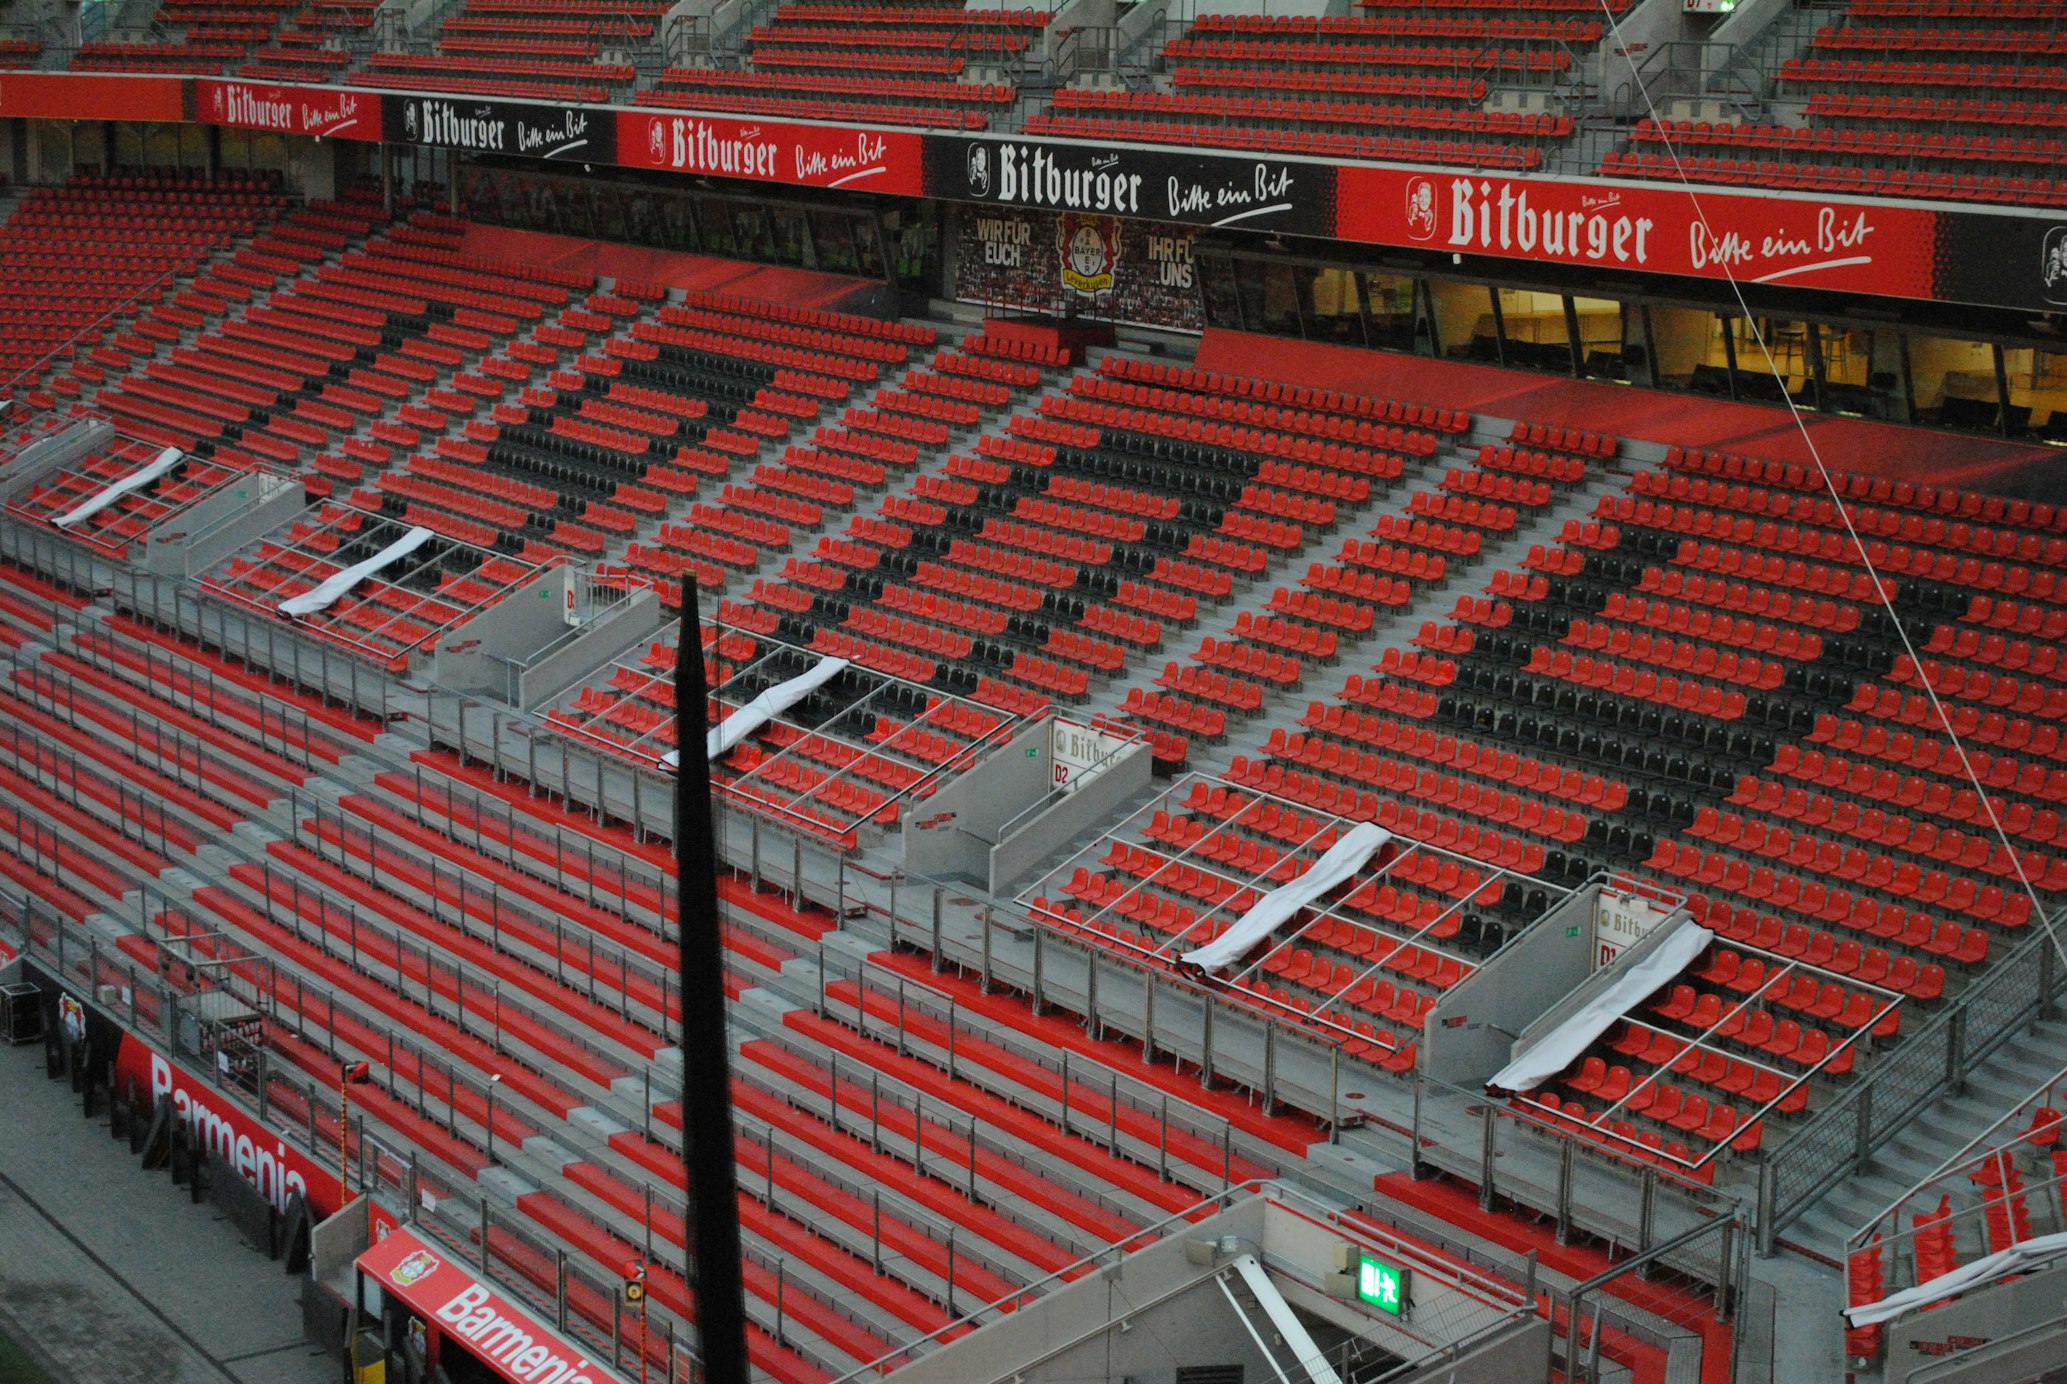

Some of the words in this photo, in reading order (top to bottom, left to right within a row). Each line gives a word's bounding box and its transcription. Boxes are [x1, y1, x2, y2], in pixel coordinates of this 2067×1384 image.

[227, 85, 292, 128] Bitburger
[302, 104, 323, 130] Bitte
[324, 106, 340, 123] ein
[340, 94, 358, 118] Bit
[423, 100, 505, 150] Bitburger
[518, 121, 544, 151] Bitte
[545, 124, 565, 142] ein
[566, 110, 588, 139] Bit
[672, 118, 777, 177] Bitburger
[795, 144, 828, 179] Bitte
[831, 149, 856, 169] ein
[858, 133, 887, 165] Bit
[998, 144, 1142, 213] Bitburger
[1168, 176, 1212, 216] Bitte
[1216, 181, 1251, 206] ein
[1255, 163, 1294, 201] Bit
[977, 218, 1003, 243] WIR
[1004, 216, 1031, 246] FÜR
[1448, 178, 1654, 264] Bitburger
[1690, 221, 1754, 269] Bitte
[1760, 228, 1811, 258] ein
[1818, 207, 1875, 252] Bit
[985, 240, 1021, 267] EUCH
[1074, 245, 1101, 256] BAYER
[1149, 235, 1175, 261] IHR
[1161, 261, 1193, 288] UNS
[1055, 764, 1068, 784] D2
